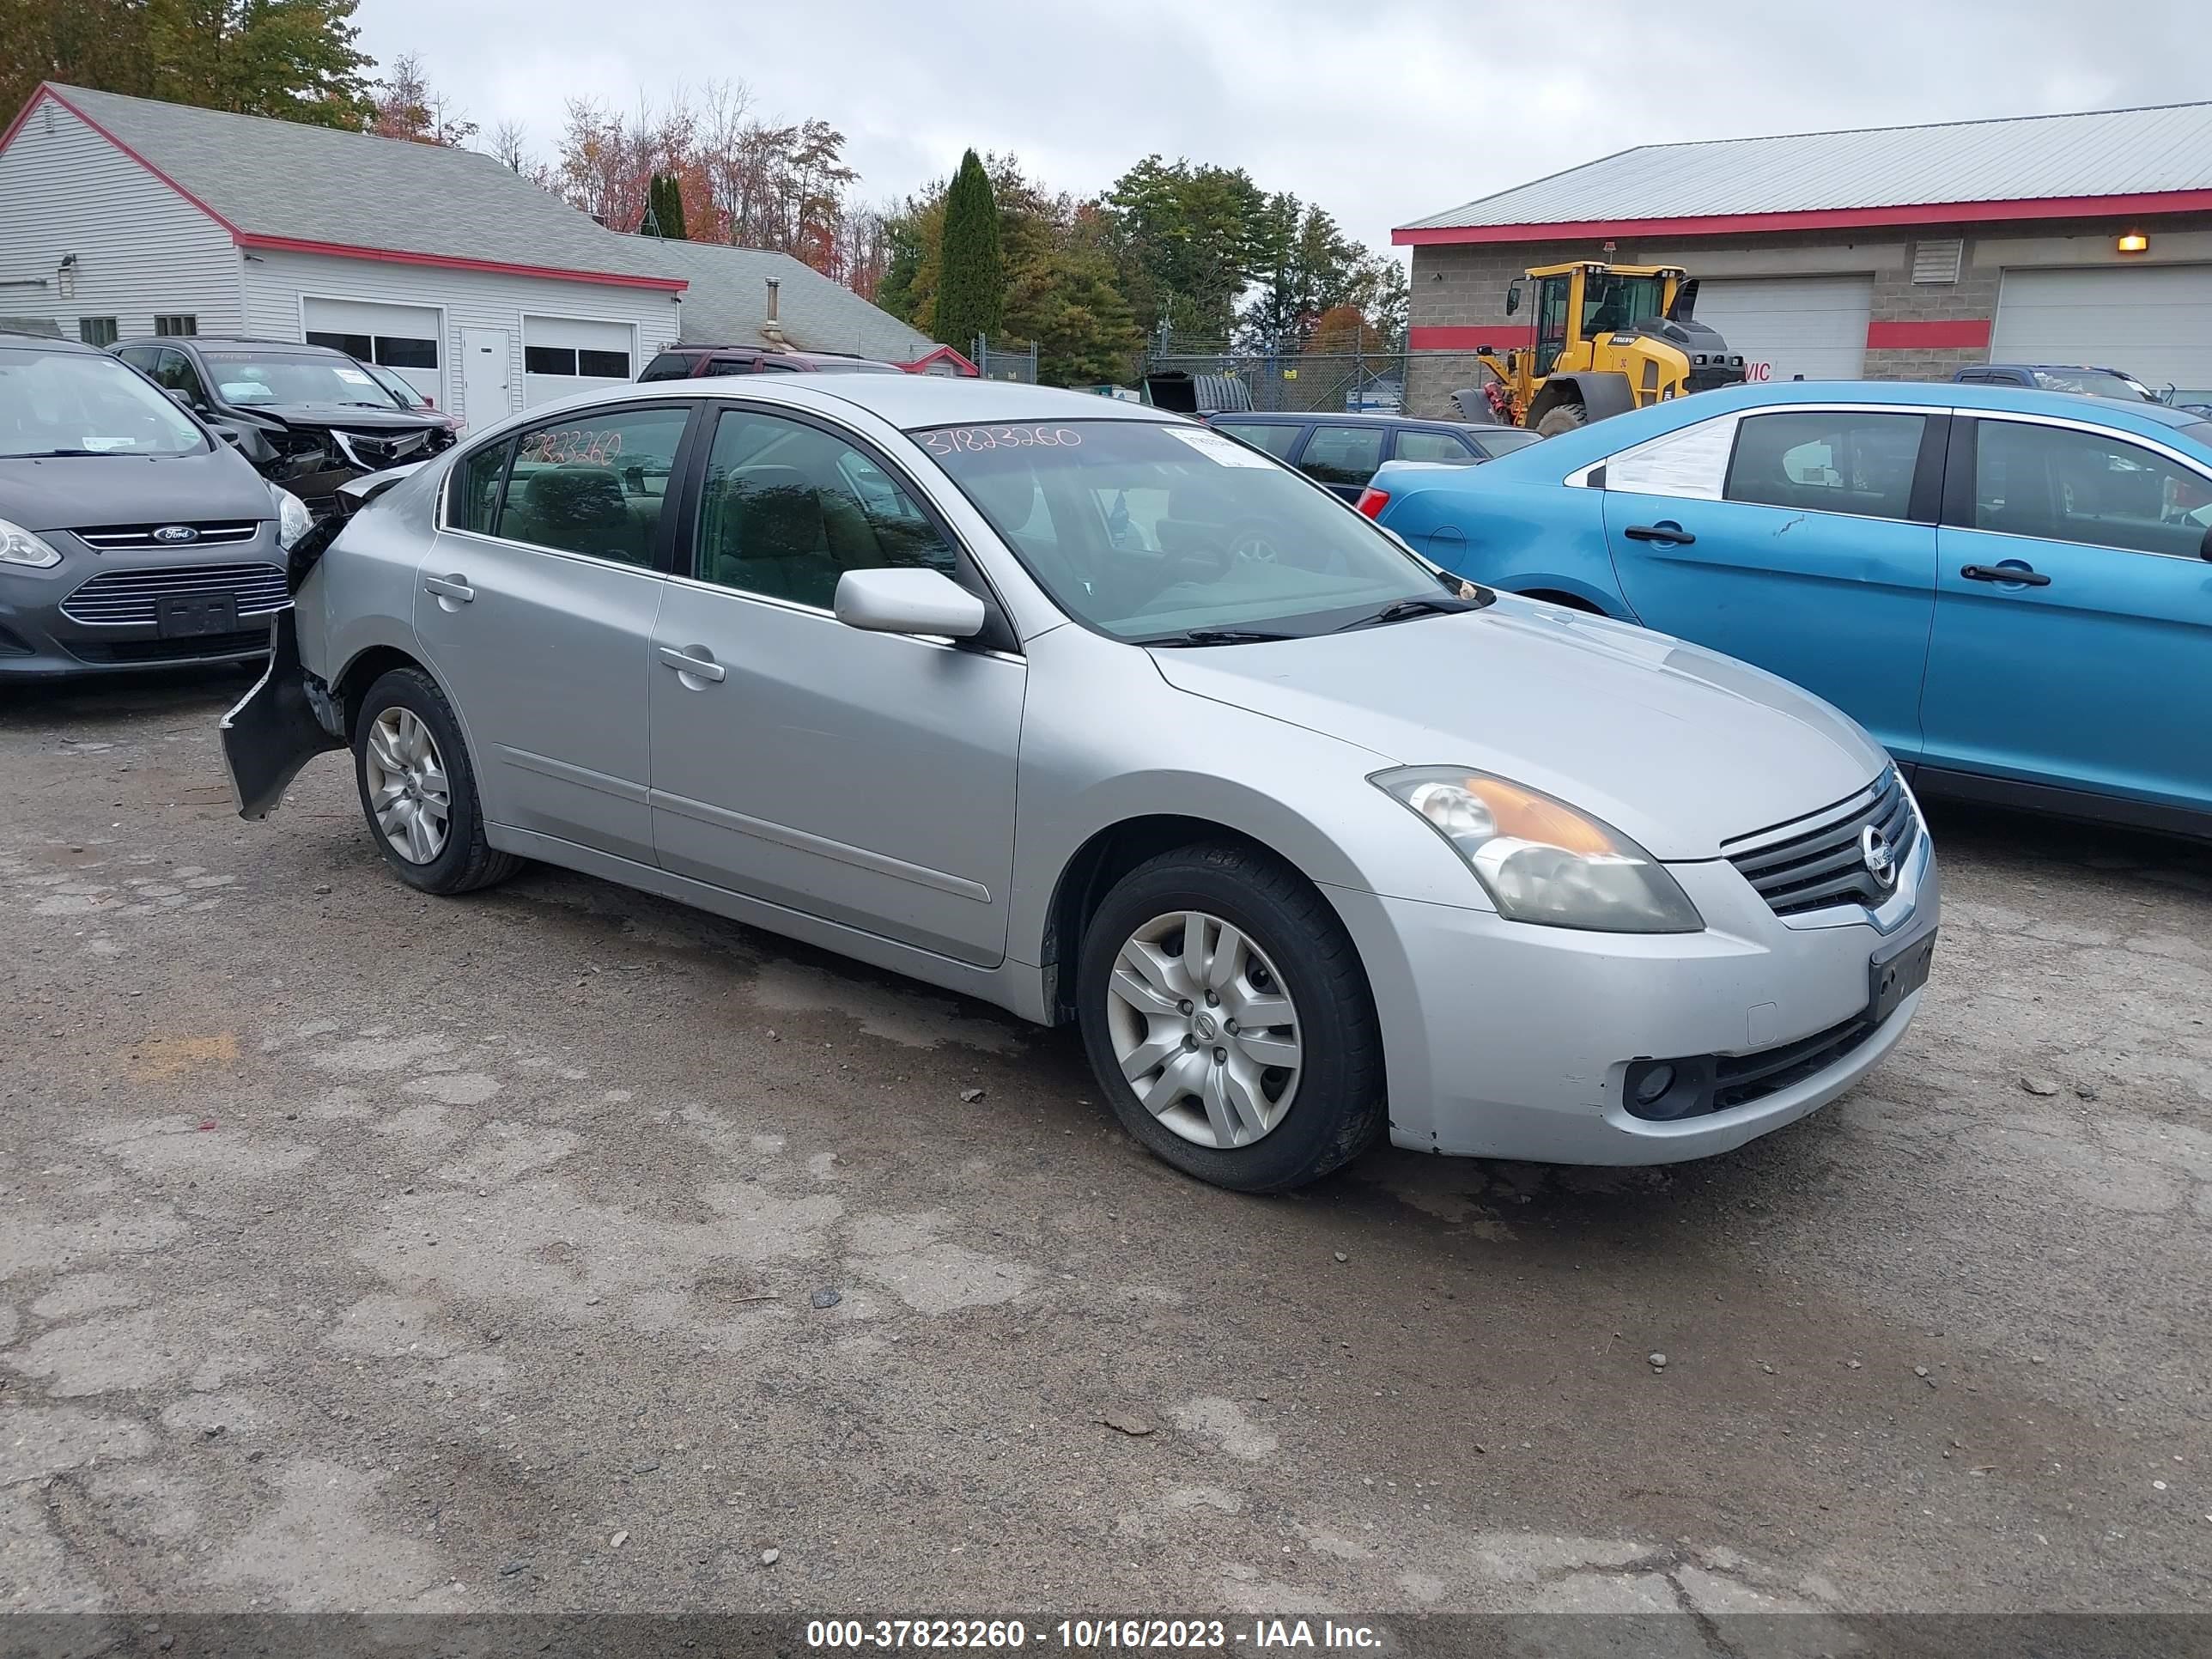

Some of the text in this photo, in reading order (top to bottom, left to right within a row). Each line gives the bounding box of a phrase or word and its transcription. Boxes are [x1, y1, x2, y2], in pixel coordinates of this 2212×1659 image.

[521, 430, 622, 465] 37823260
[920, 427, 1081, 455] 37823260
[165, 528, 189, 539] Ford
